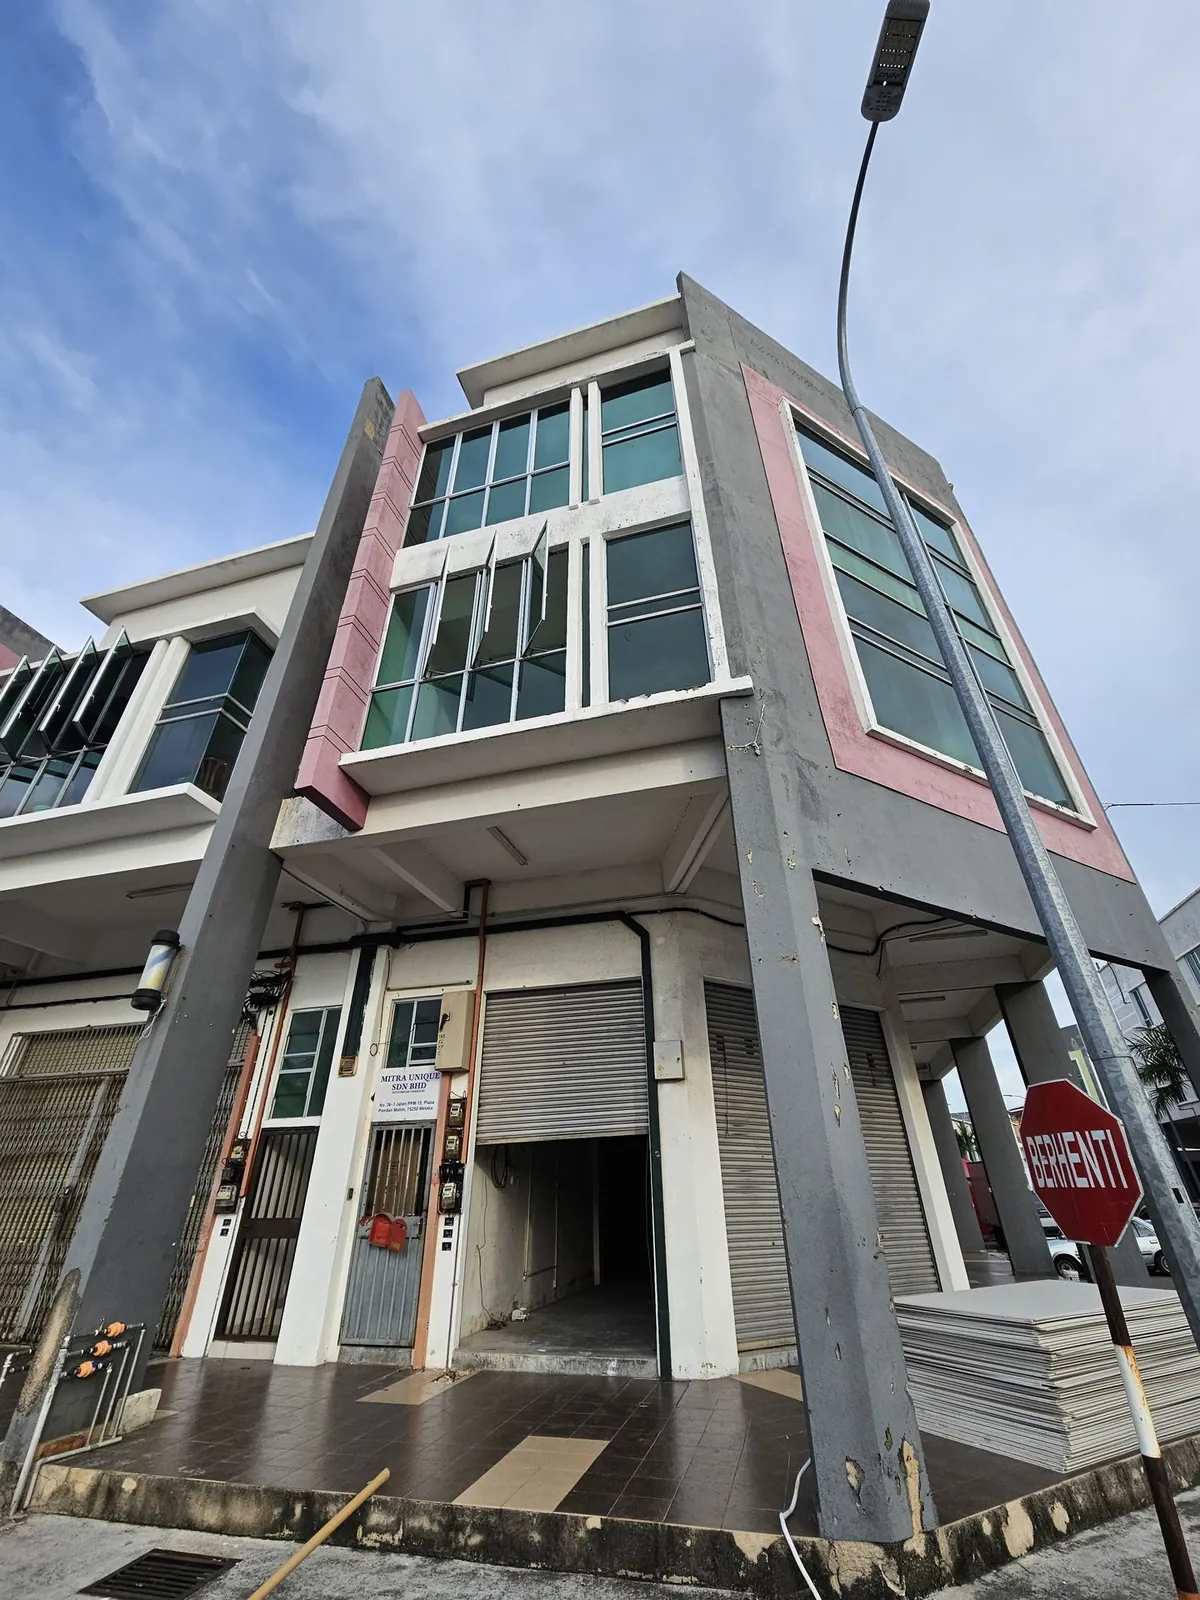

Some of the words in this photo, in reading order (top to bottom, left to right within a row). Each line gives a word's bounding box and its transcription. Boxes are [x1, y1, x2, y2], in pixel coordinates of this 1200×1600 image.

[408, 1072, 441, 1082] UNIQUE
[391, 1083, 408, 1091] SDN
[409, 1082, 427, 1090] BHD
[1025, 1129, 1129, 1189] BERHENTI
